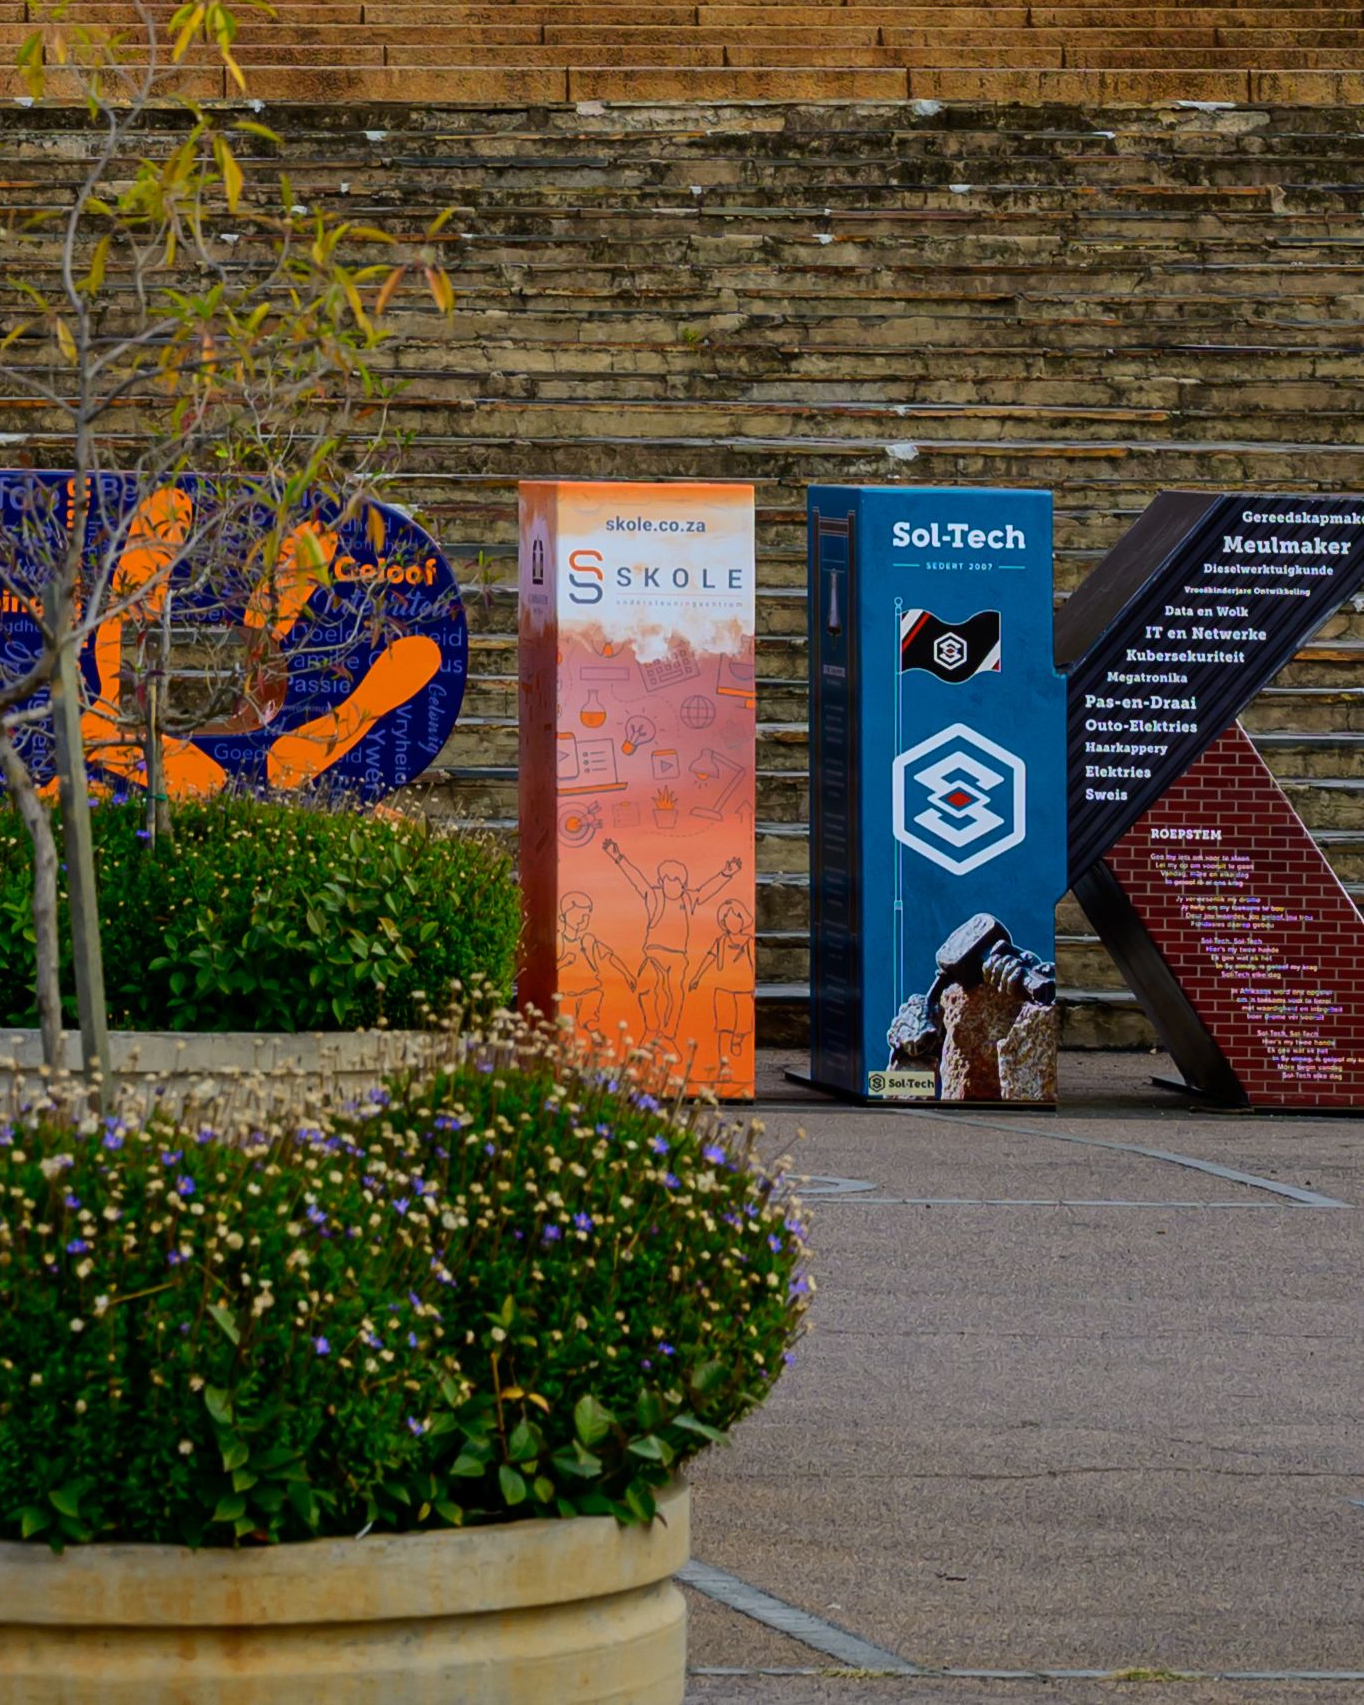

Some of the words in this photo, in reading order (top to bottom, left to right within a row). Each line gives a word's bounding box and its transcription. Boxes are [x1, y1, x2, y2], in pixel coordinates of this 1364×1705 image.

[606, 517, 706, 533] skole.co.za
[893, 521, 1026, 549] Sol-Tech
[1223, 536, 1352, 555] Meulmaker
[334, 556, 438, 586] Geloof
[926, 562, 964, 570] SEDERT
[969, 563, 993, 571] 2007
[1203, 563, 1334, 577] Dieselwerktuigkunde
[616, 567, 743, 589] SKOLE
[1254, 587, 1311, 597] Ontwikkeling
[1165, 606, 1194, 617] Data
[1198, 608, 1213, 617] en
[1216, 606, 1248, 617] Wolk
[1145, 626, 1163, 639] IT
[1168, 628, 1187, 639] en
[1192, 627, 1267, 640] Netwerke
[1126, 649, 1245, 663] Kubersekuriteit
[1107, 672, 1188, 684] Megatronika
[1085, 695, 1197, 710] Pas-en-Draai
[1085, 719, 1198, 733] Outo-Elektries
[1085, 742, 1168, 755] Haarkappery
[1085, 766, 1152, 779] Elektries
[1085, 789, 1128, 801] Sweis
[1151, 828, 1222, 839] ROEPSTEM
[888, 1078, 935, 1088] Sol-Tech
